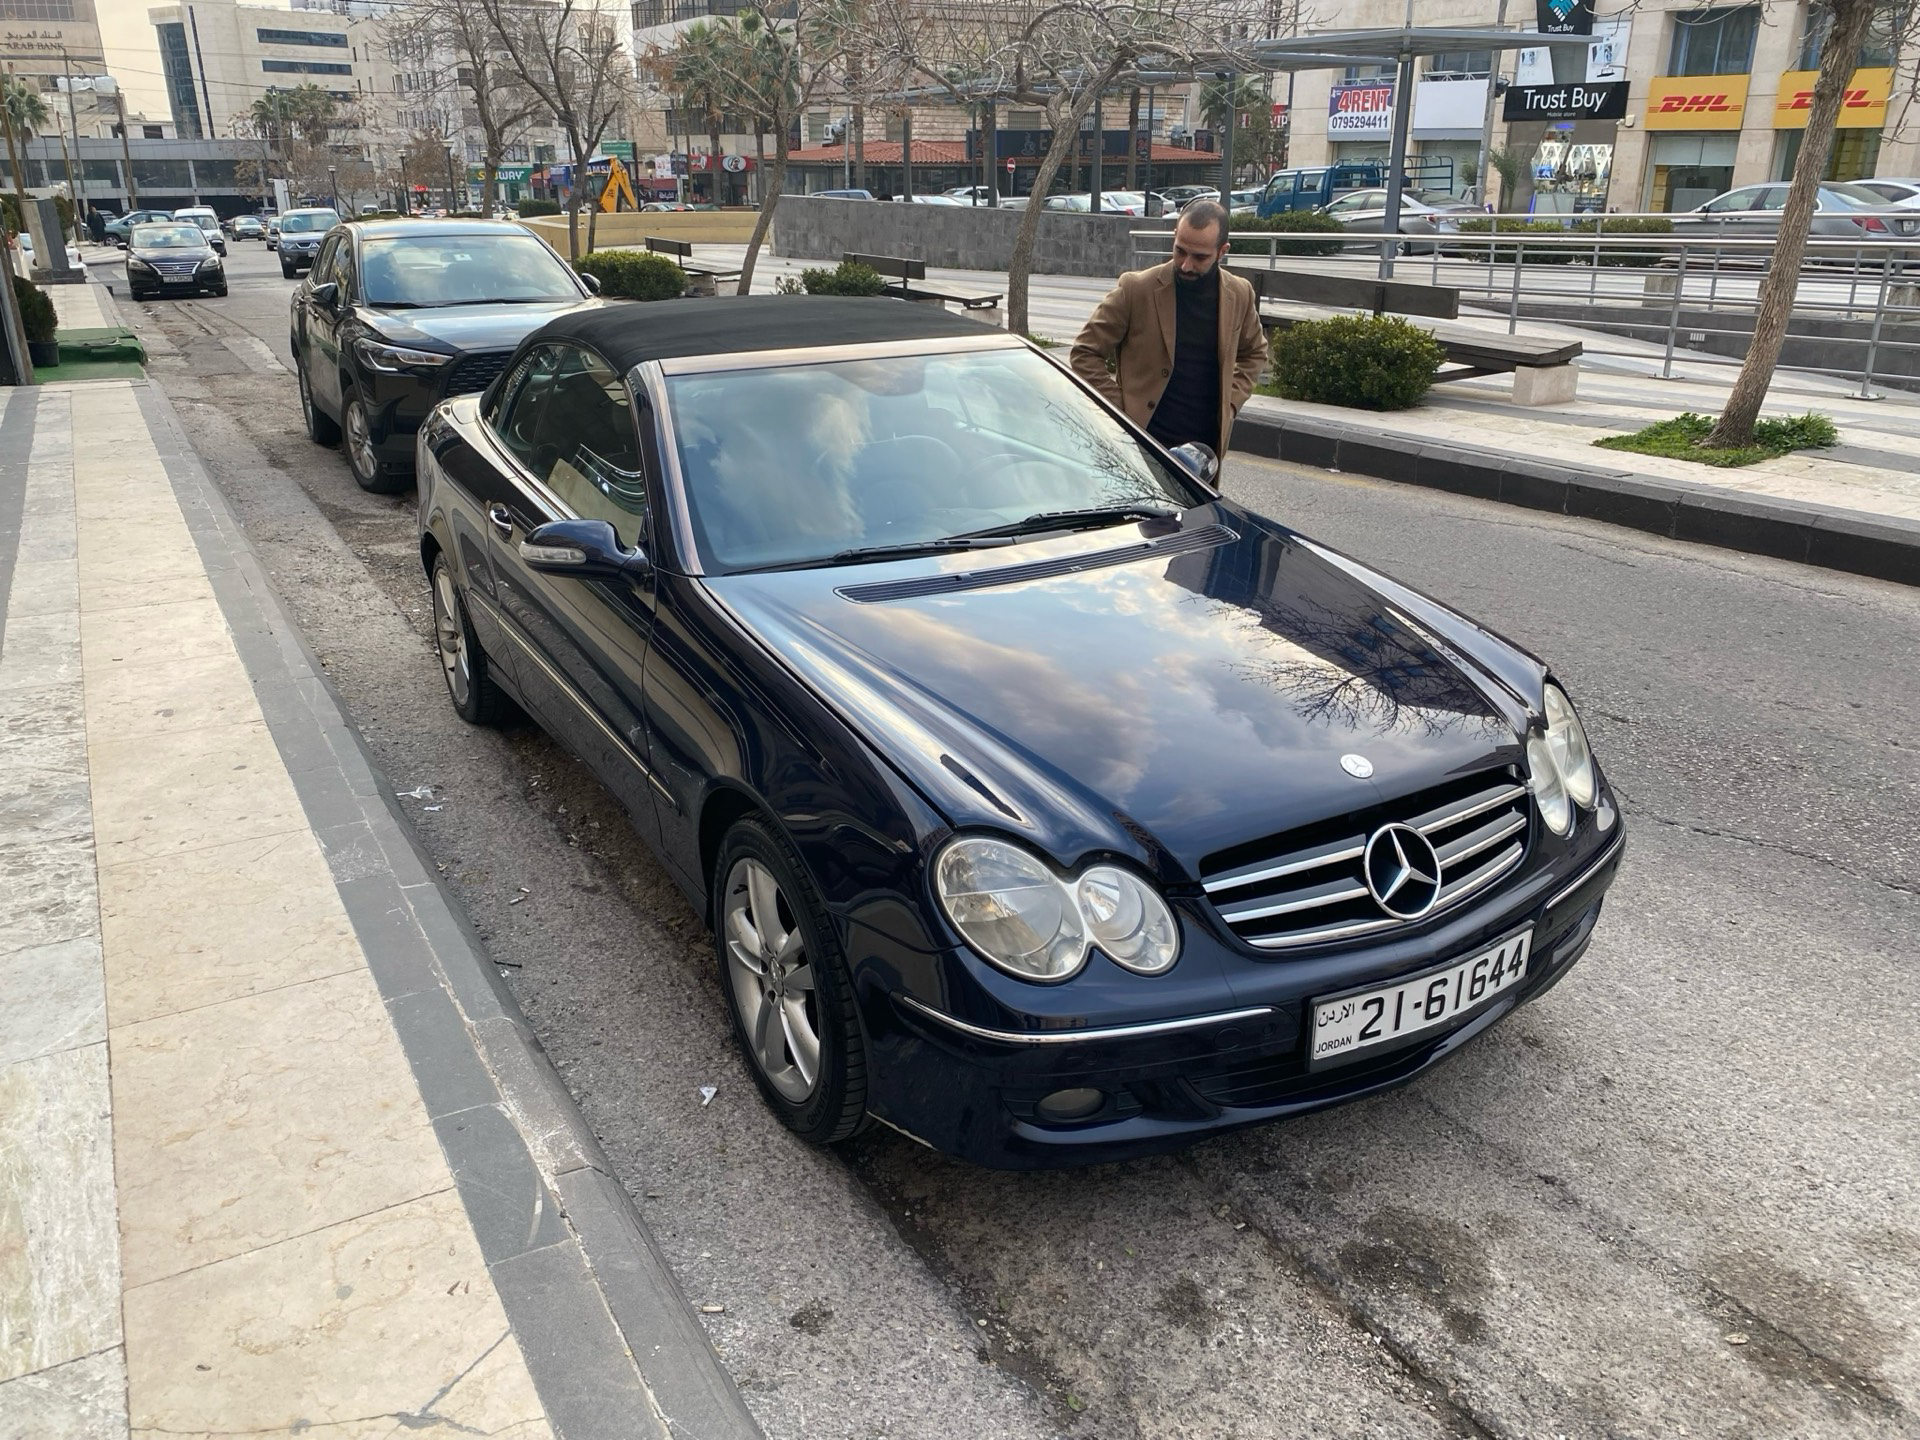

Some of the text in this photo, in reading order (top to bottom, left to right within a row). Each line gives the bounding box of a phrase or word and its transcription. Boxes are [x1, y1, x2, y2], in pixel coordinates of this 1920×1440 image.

[1547, 23, 1575, 33] Trust Buy
[6, 41, 64, 51] ARAB BANK
[1338, 89, 1391, 113] 4RENT
[1523, 87, 1607, 113] Trust Buy
[1658, 94, 1732, 113] DHL
[1331, 115, 1388, 129] 0795294411
[478, 172, 532, 184] SWAY
[1357, 939, 1525, 1042] 21-61644
[1315, 1035, 1353, 1054] JORDAN
